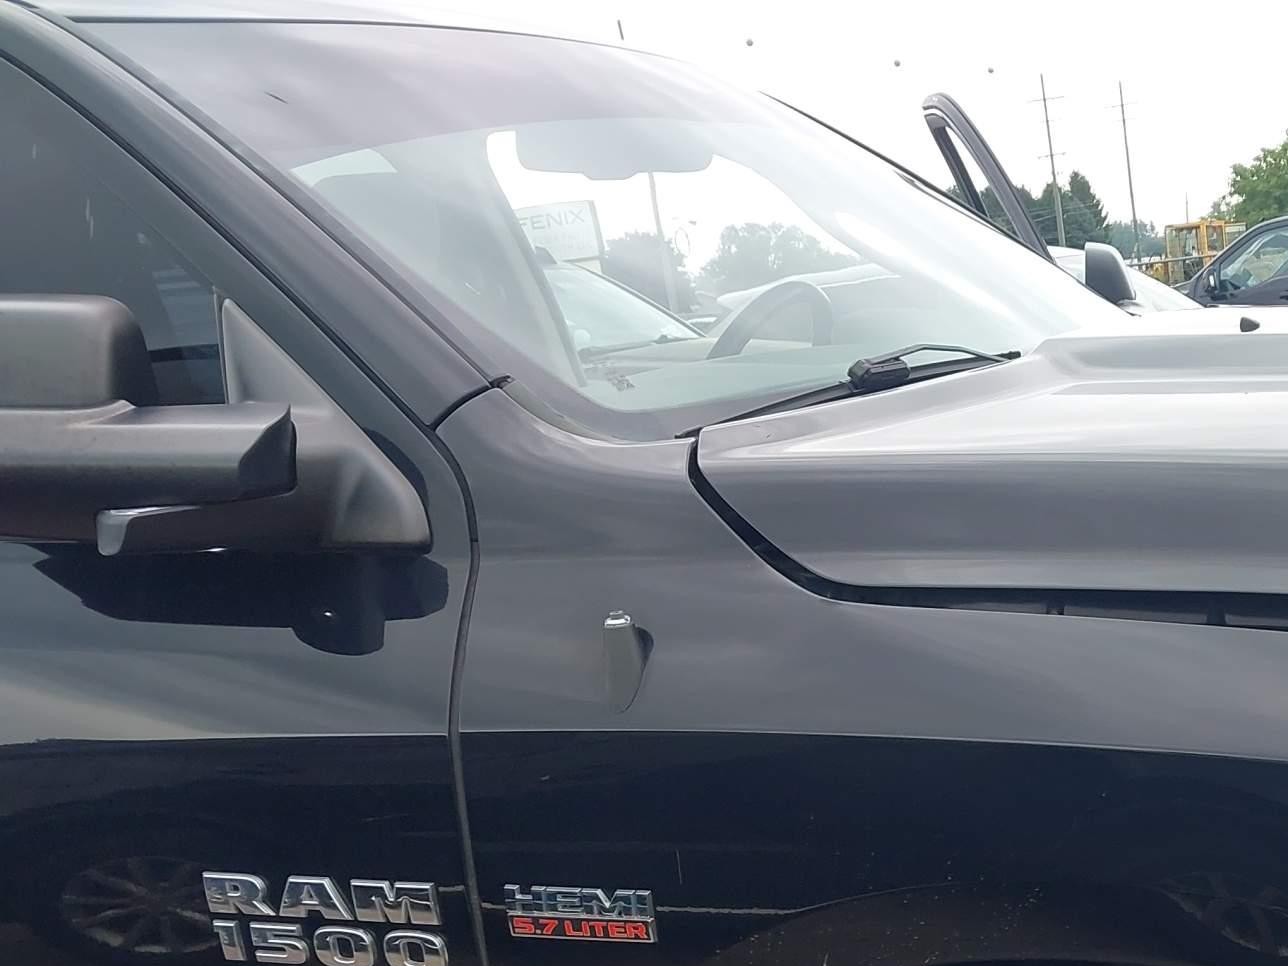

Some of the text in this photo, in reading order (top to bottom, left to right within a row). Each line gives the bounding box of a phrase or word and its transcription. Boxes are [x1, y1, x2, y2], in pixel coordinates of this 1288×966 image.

[202, 871, 441, 926] RAM
[503, 883, 655, 918] HEMI
[512, 917, 649, 939] 5.7 LITER
